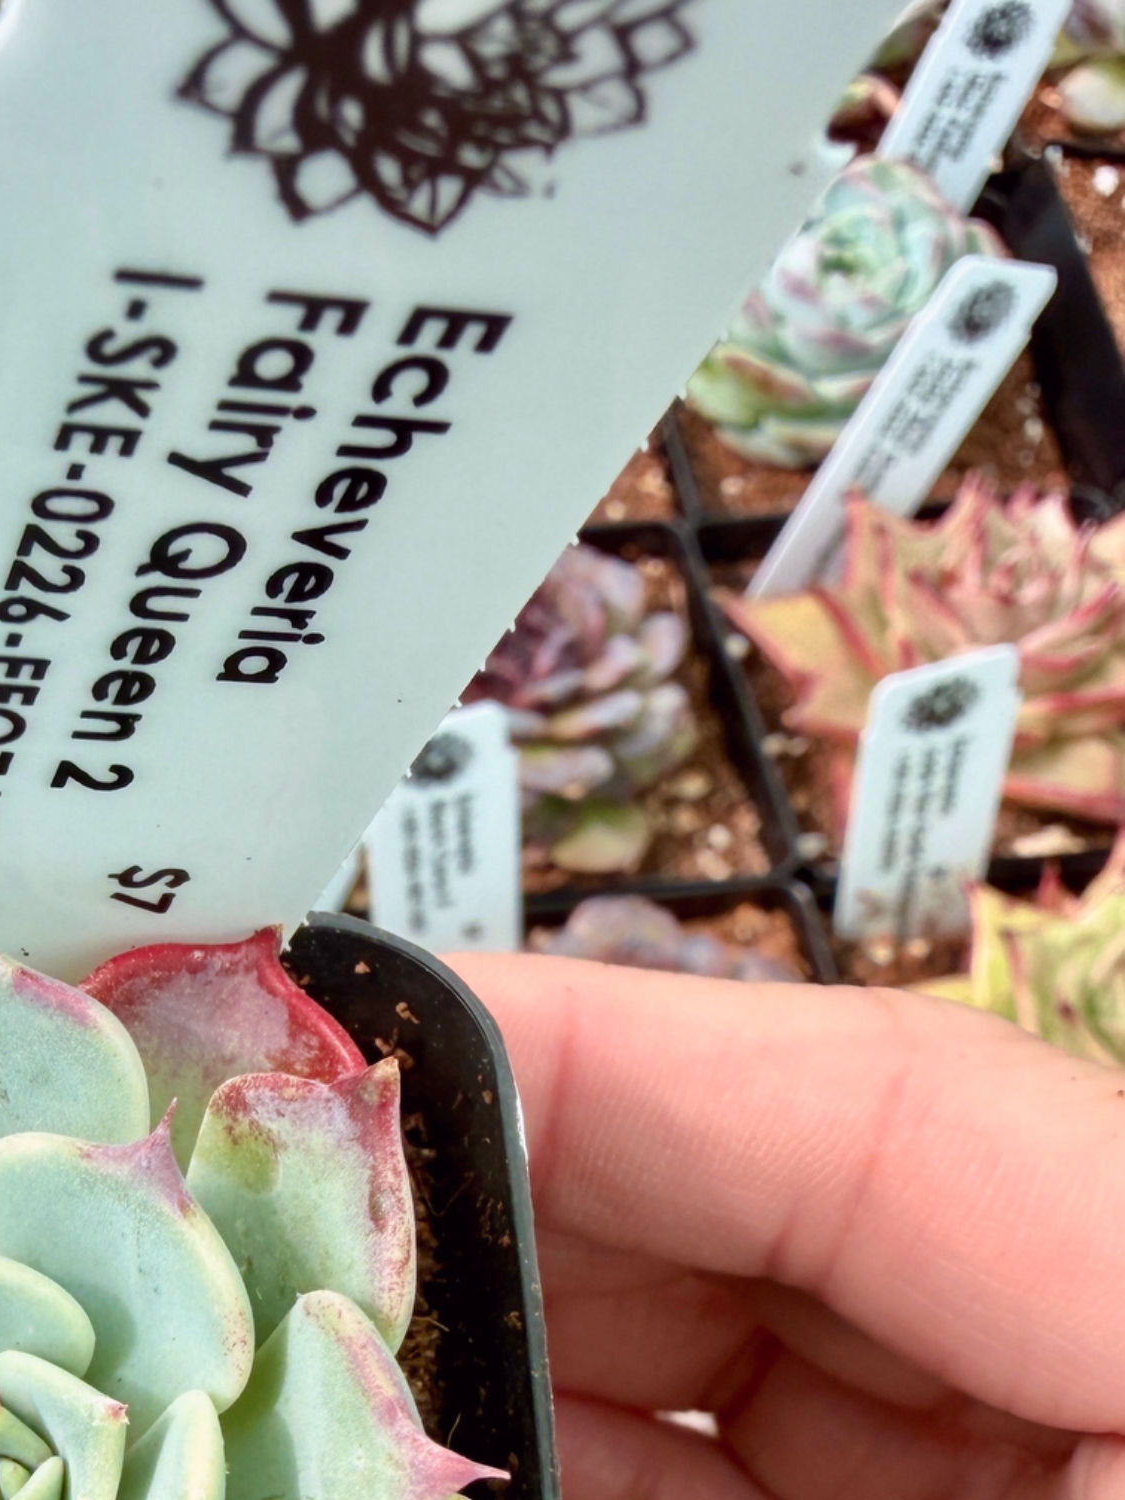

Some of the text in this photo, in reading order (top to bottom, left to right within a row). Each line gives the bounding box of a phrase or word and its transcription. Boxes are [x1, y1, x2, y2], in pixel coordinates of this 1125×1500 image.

[50, 290, 370, 792] Fairy Queen 2
[216, 306, 513, 683] Echeveria
[107, 865, 191, 914] $7
